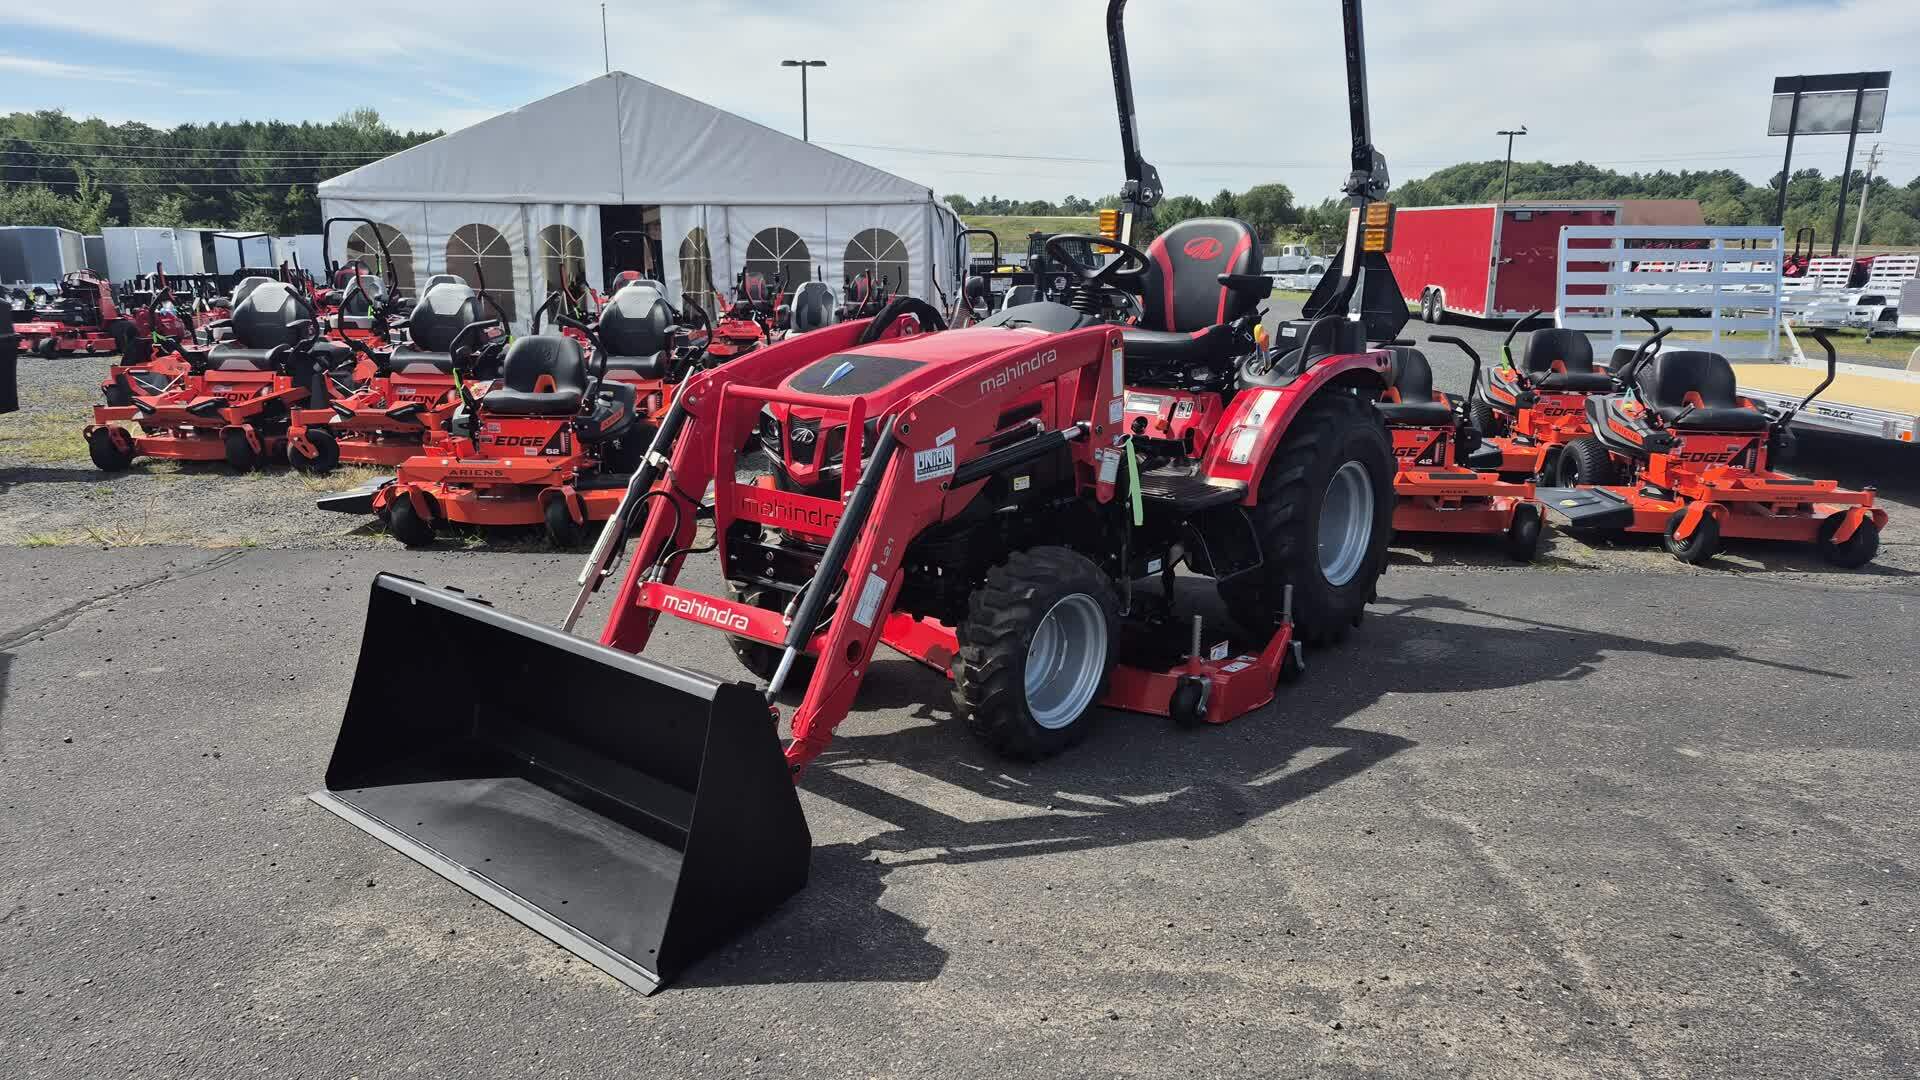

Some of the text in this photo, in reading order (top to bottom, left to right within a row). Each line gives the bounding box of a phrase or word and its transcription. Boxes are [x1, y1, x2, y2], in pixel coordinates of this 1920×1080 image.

[981, 350, 1056, 394] mahindra
[213, 392, 249, 402] IKON
[399, 395, 435, 403] IKON
[1543, 408, 1585, 417] EDGE
[1817, 407, 1854, 420] TRACK
[495, 436, 545, 446] EDGE
[1392, 447, 1421, 457] GE
[1679, 452, 1731, 462] EDGE
[742, 498, 842, 529] mahindra
[662, 594, 749, 631] mahindra
